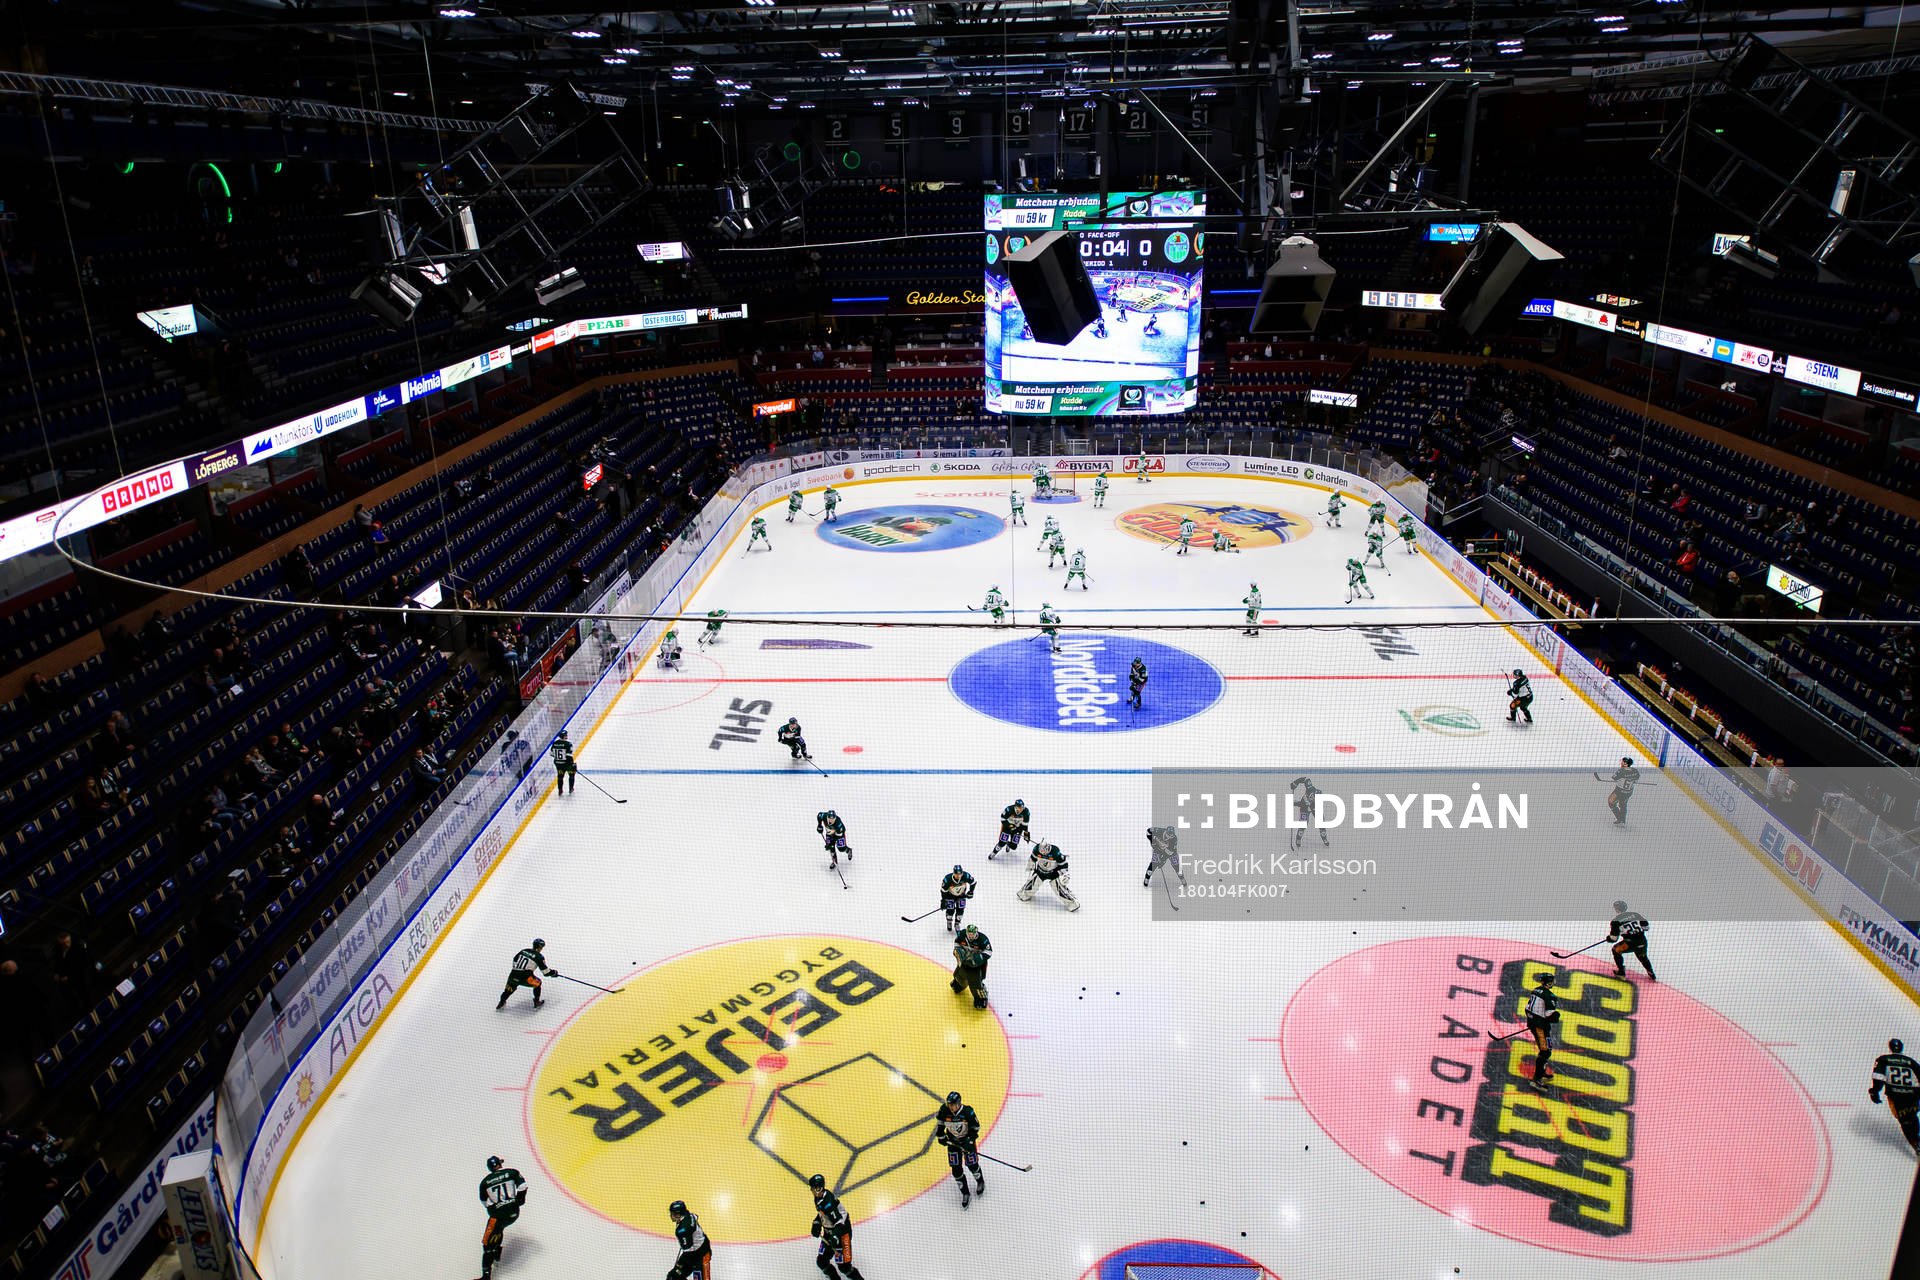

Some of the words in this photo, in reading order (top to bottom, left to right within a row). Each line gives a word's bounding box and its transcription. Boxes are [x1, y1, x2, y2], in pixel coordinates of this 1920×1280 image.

[832, 120, 842, 138] 2
[892, 119, 901, 136] 5
[952, 117, 962, 135] 9
[1012, 115, 1022, 133] 9
[1070, 113, 1086, 131] 17
[1130, 112, 1147, 129] 21
[1015, 197, 1058, 207] Matchens
[1058, 197, 1101, 208] erbjudan
[1015, 214, 1026, 223] nu
[1026, 212, 1037, 223] 59
[1038, 212, 1047, 223] kr
[1139, 239, 1152, 256] 0
[906, 291, 960, 305] Golden
[960, 290, 985, 305] Sta
[586, 318, 624, 332] PEAB
[1813, 362, 1839, 380] STENA
[408, 374, 441, 398] Helmia
[1015, 385, 1056, 394] Matchens
[1056, 385, 1104, 395] erbjudande
[1015, 400, 1024, 409] nu
[1025, 399, 1036, 410] 59
[1037, 399, 1046, 409] kr
[325, 407, 359, 427] UDDEHOLM
[274, 422, 314, 448] Munkfors
[195, 454, 239, 481] LÖFBERGS
[863, 463, 921, 477] goodtech
[943, 462, 981, 471] ŠKODA
[1069, 462, 1110, 470] BYGMA
[1244, 461, 1279, 473] Lumine
[1281, 465, 1299, 475] LED
[807, 473, 842, 485] Swedbank
[1315, 471, 1349, 488] charden
[102, 471, 174, 513] CRAMO
[1074, 557, 1080, 566] 6
[1789, 579, 1811, 600] ENERGI
[987, 595, 994, 604] 21
[1049, 639, 1119, 727] NordicBet
[708, 697, 773, 751] SHL
[474, 825, 502, 864] Office
[477, 838, 503, 877] DEPOT
[1759, 821, 1822, 894] ELON
[287, 926, 367, 1032] Gårdfeldts
[364, 898, 389, 938] Kyl
[329, 972, 394, 1076] ATEA
[549, 947, 843, 1101] BYGGMATERIAL
[569, 958, 895, 1143] BEIJER
[1409, 954, 1494, 1177] BLADET
[1889, 1066, 1913, 1086] 22
[1461, 958, 1638, 1238] SPORT
[491, 1182, 513, 1203] 71
